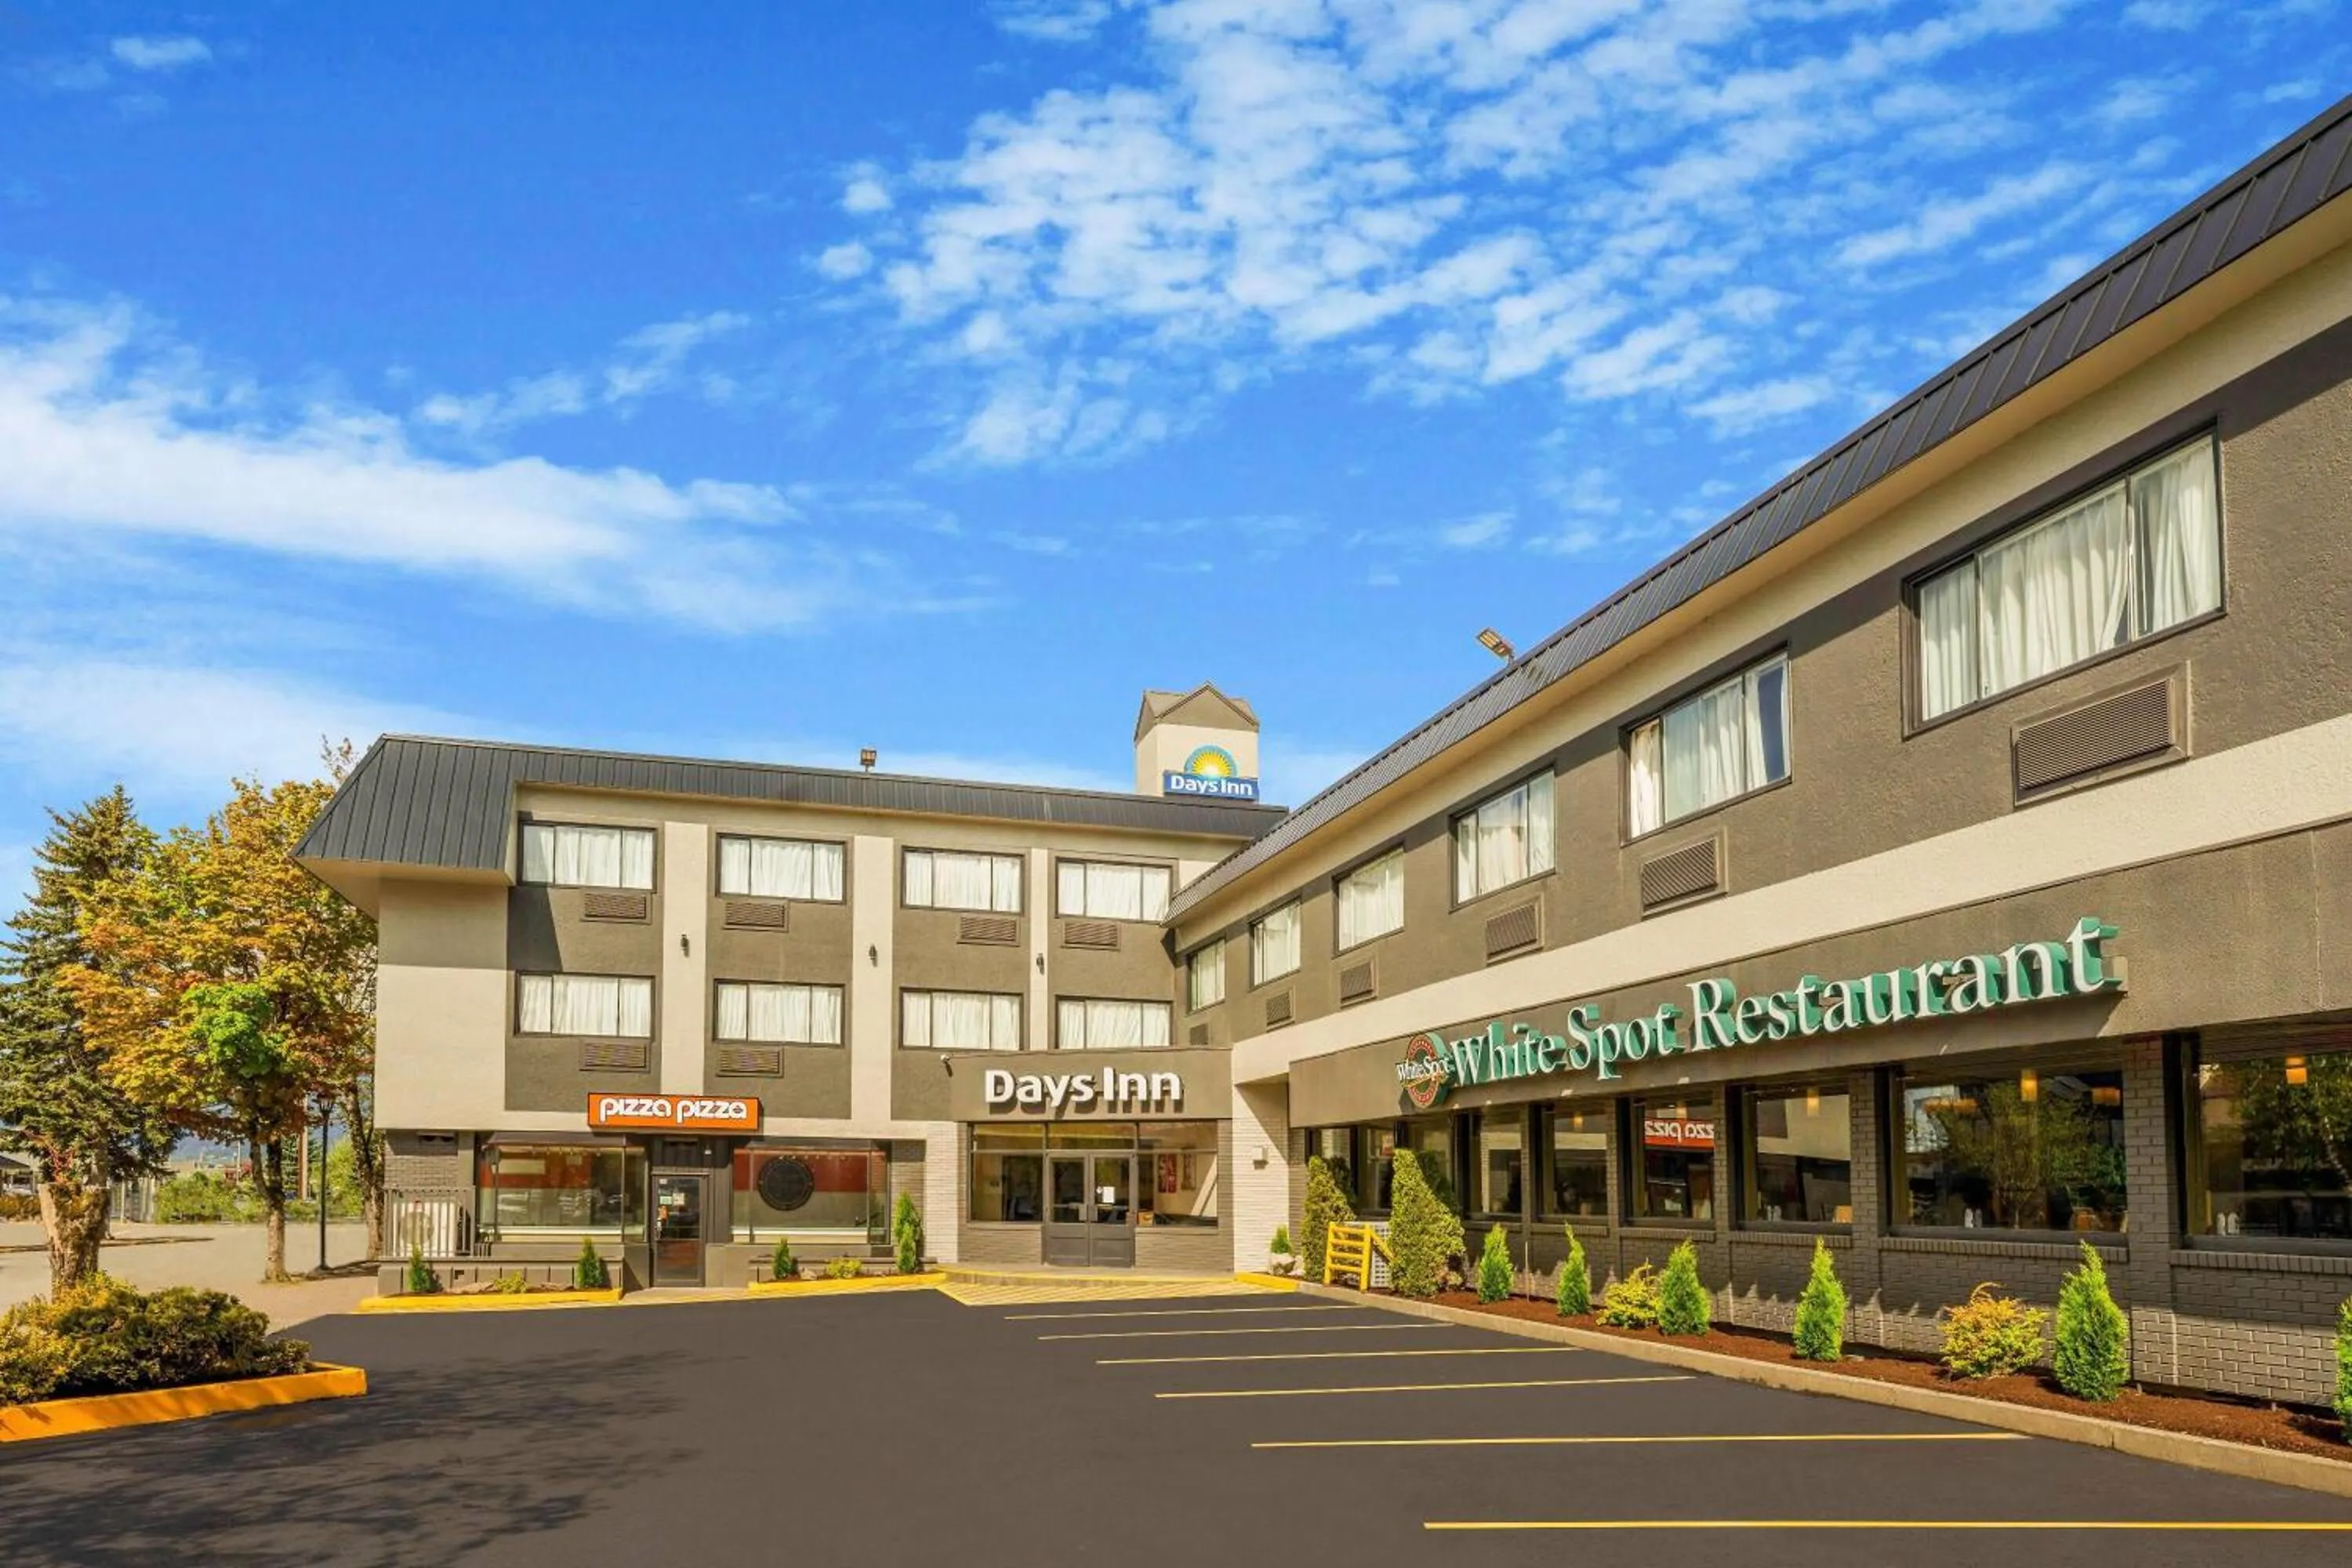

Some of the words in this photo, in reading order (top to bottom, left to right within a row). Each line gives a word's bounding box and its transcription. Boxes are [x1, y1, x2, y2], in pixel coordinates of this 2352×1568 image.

[1171, 775, 1218, 793] Days
[1221, 779, 1253, 796] Inn
[1450, 1021, 1566, 1085] White
[1566, 1003, 1686, 1080] Spot
[1685, 916, 2122, 1051] Restaurant
[985, 1069, 1096, 1107] Days
[1103, 1066, 1181, 1102] Inn
[599, 1098, 672, 1123] pizza
[677, 1100, 747, 1124] pizza
